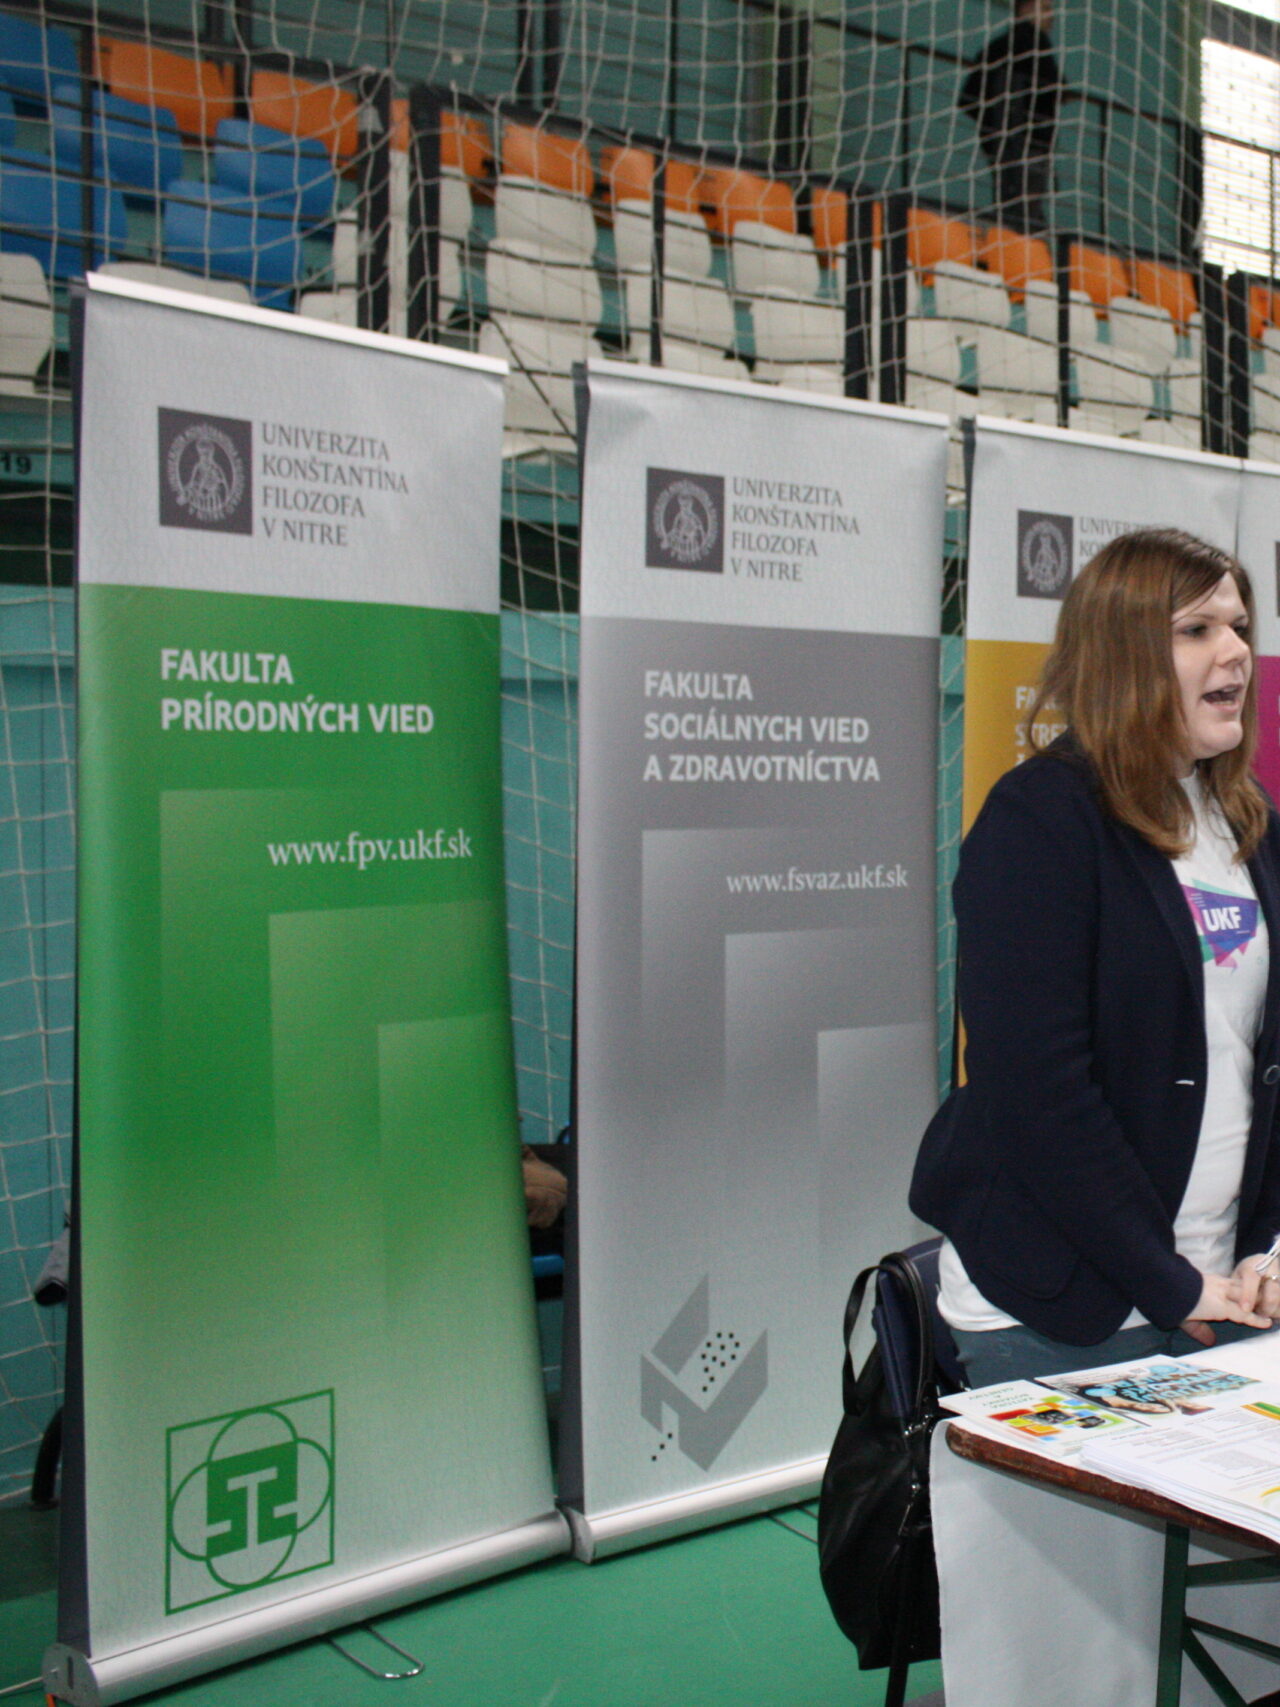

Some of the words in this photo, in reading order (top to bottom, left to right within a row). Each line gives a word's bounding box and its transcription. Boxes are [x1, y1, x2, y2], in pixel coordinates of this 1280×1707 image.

[261, 422, 390, 462] UNIVERZITA
[261, 453, 409, 494] KONŠTANTÍNA
[262, 485, 366, 518] FILOZOFA
[732, 477, 843, 507] UNIVERZITA
[262, 517, 277, 539] V
[282, 521, 349, 546] NITRE
[731, 502, 861, 535] KONŠTANTÍNA
[731, 530, 819, 557] FILOZOFA
[730, 558, 744, 577] V
[747, 559, 803, 582] NITRE
[160, 649, 294, 685] FAKULTA
[644, 671, 753, 701] FAKULTA
[160, 691, 359, 733] PRÍRODNÝCH
[368, 703, 435, 734] VIED
[644, 707, 803, 742] SOCIÁLNYCH
[810, 716, 870, 744] VIED
[643, 754, 663, 782] A
[668, 750, 881, 783] ZDRAVOTNÍCTVA
[267, 828, 473, 870] www.fpv.ukf.sk
[726, 864, 908, 893] www.fsvaz.ukf.sk
[1202, 906, 1242, 932] UKF
